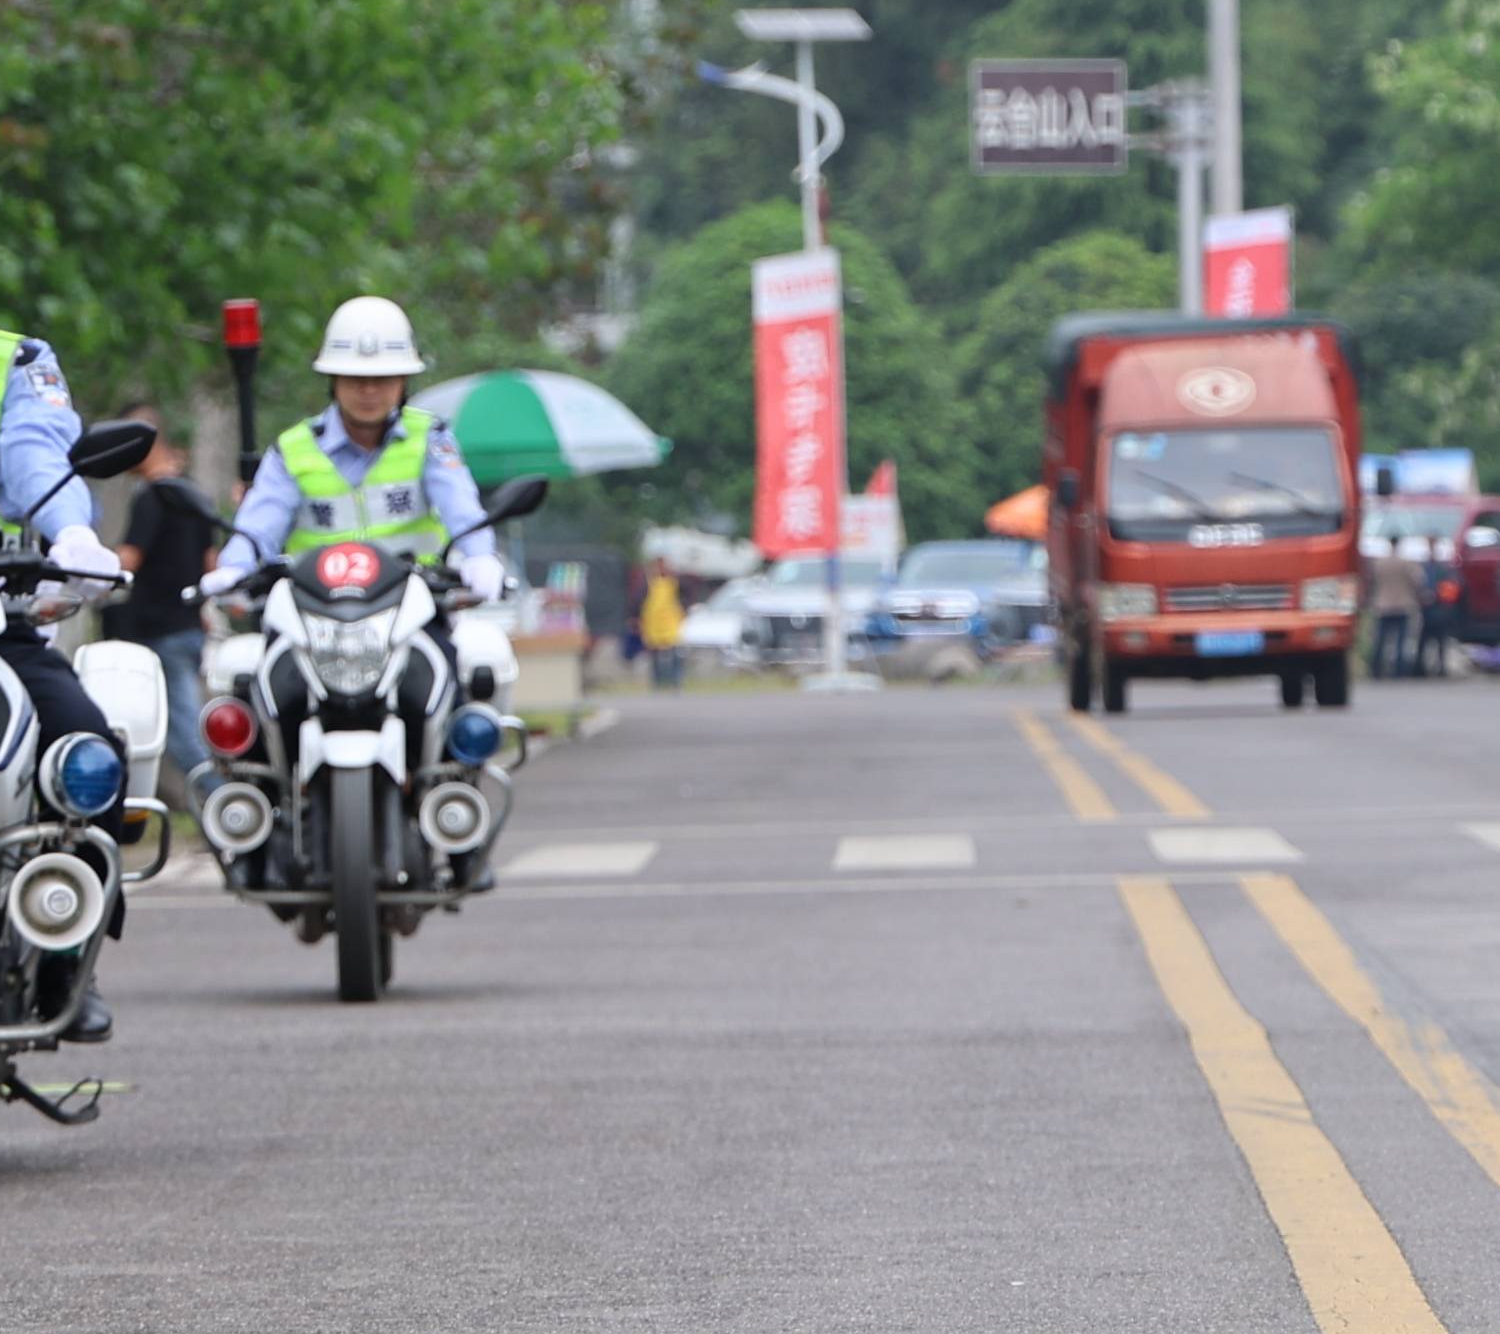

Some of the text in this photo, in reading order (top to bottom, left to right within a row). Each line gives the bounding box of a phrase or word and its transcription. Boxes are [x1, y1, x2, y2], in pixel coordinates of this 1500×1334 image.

[973, 86, 1124, 150] 云台山入口
[324, 552, 371, 581] 02
